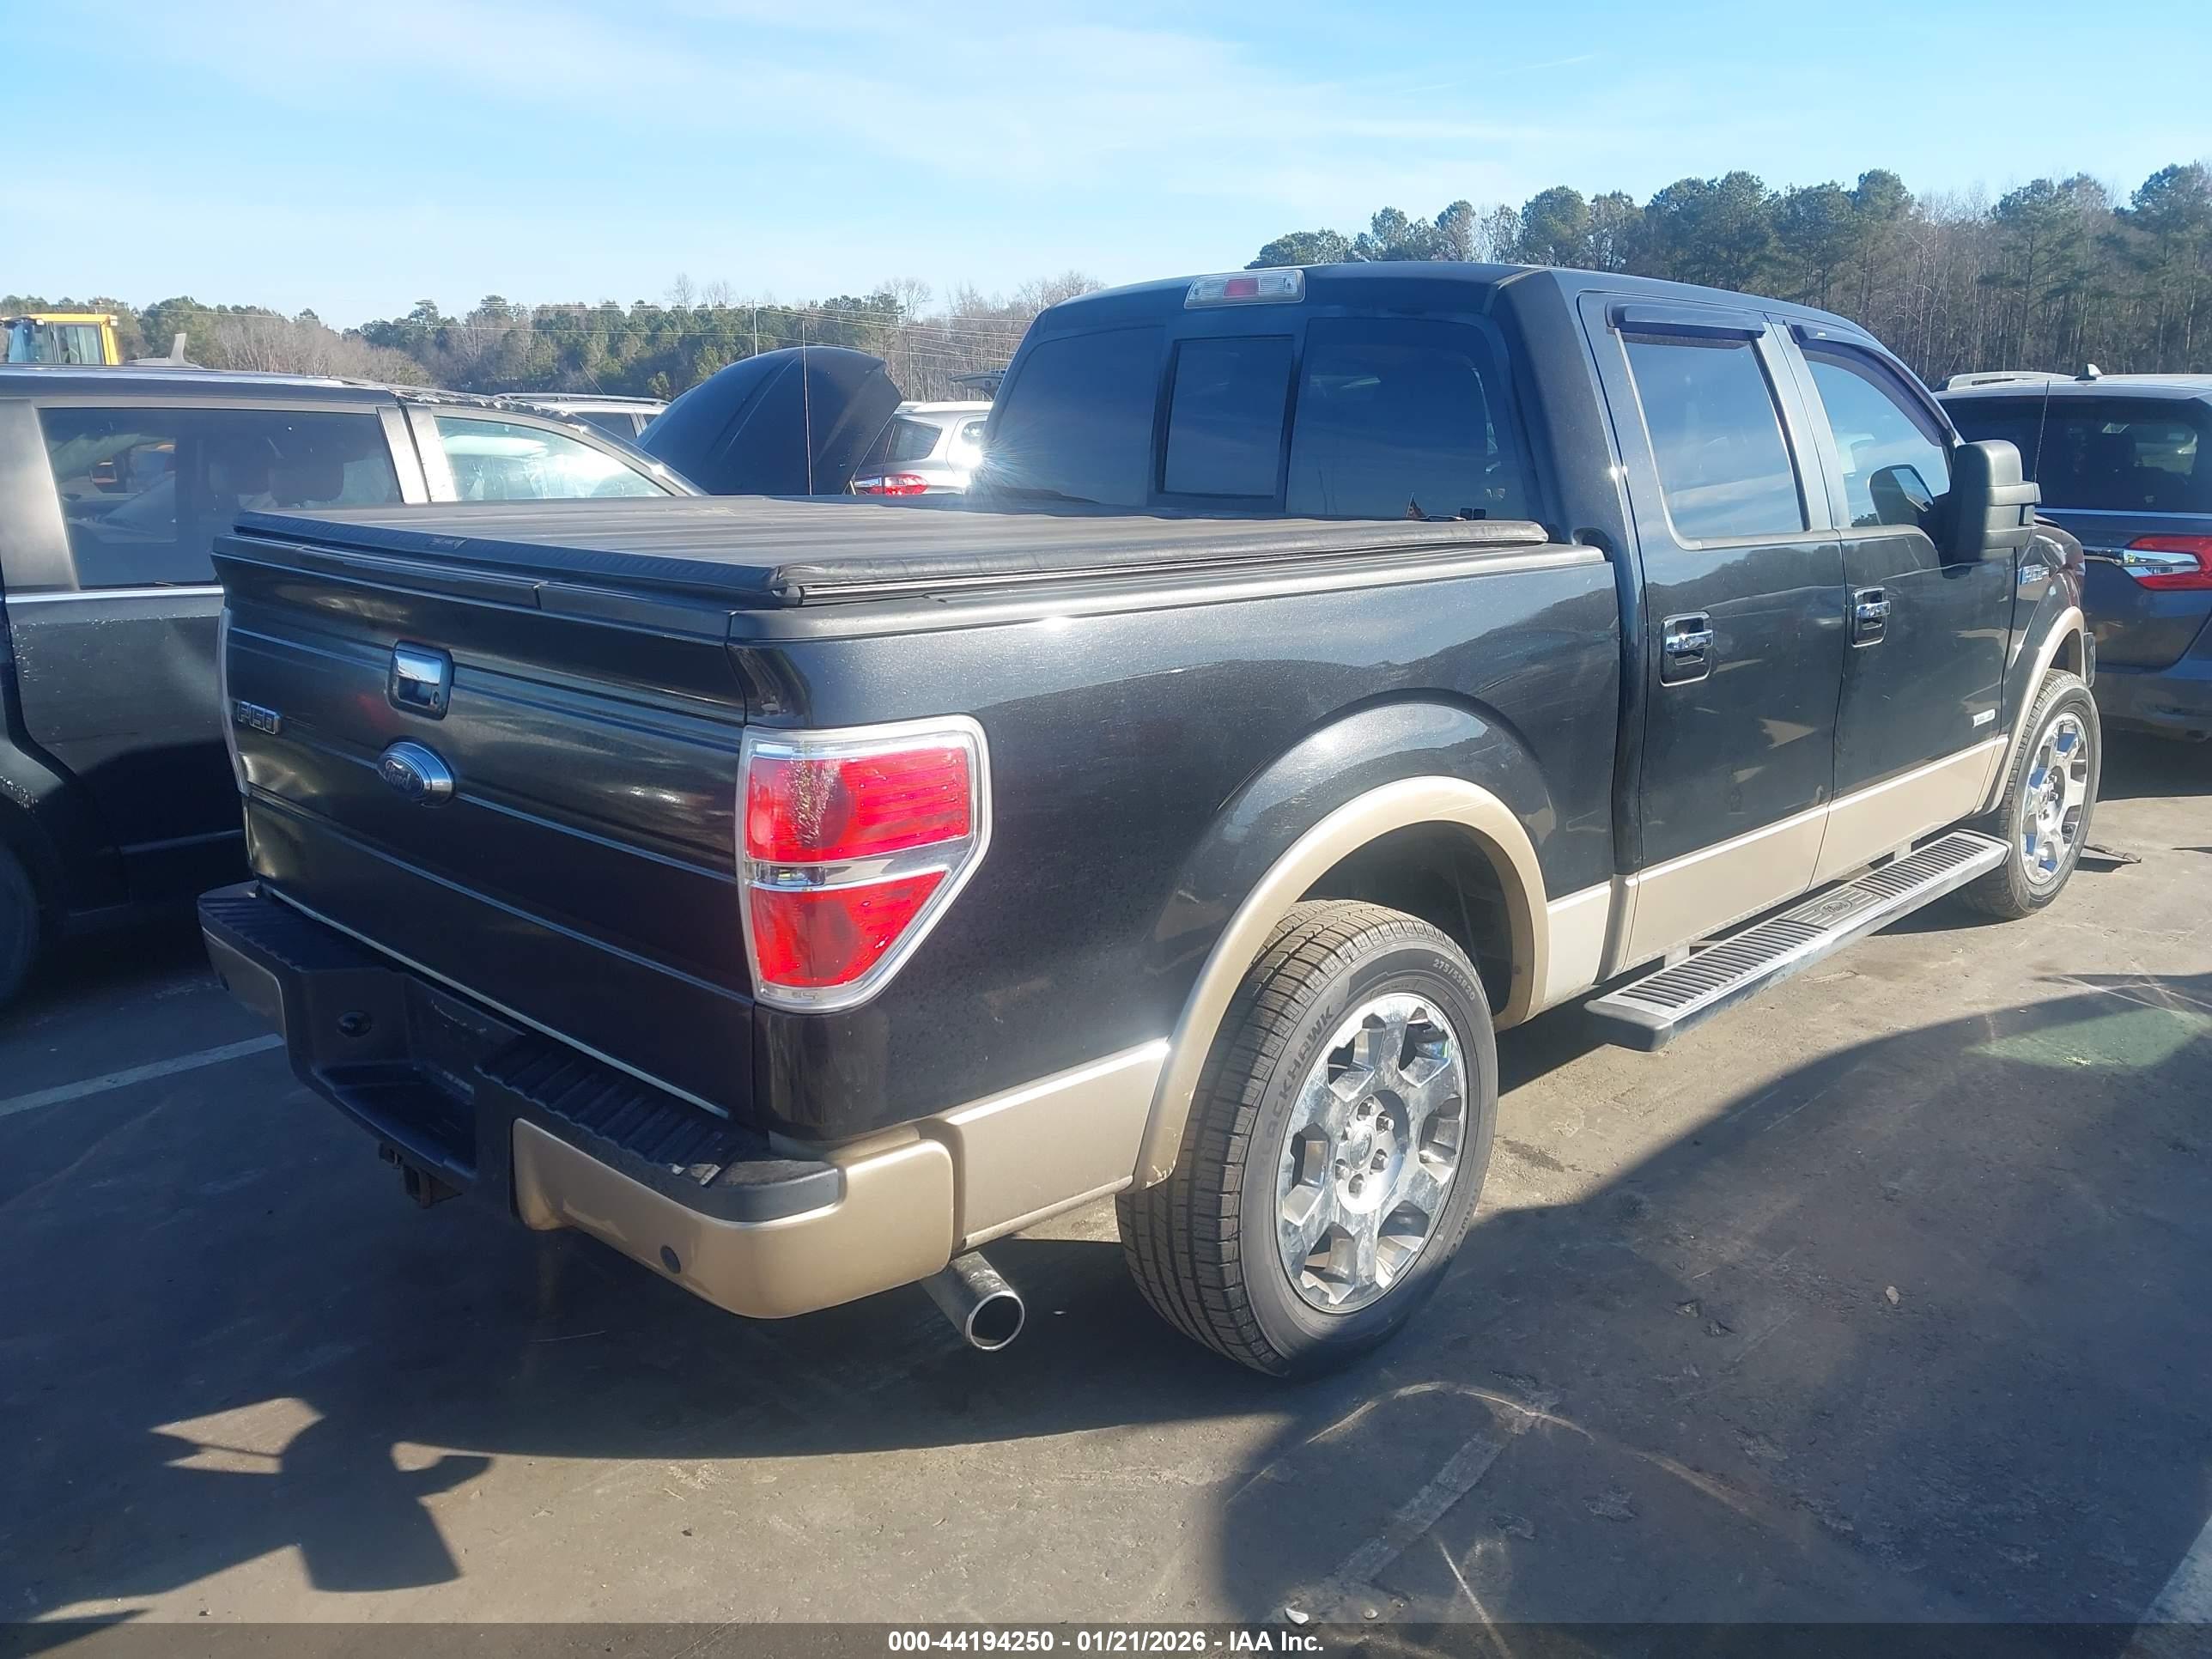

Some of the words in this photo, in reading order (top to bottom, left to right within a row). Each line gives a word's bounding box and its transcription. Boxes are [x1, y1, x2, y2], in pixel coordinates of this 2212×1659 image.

[385, 759, 411, 791] Ford
[1431, 958, 1476, 1001] 275/55R20
[1261, 1006, 1334, 1171] LACKHAWK
